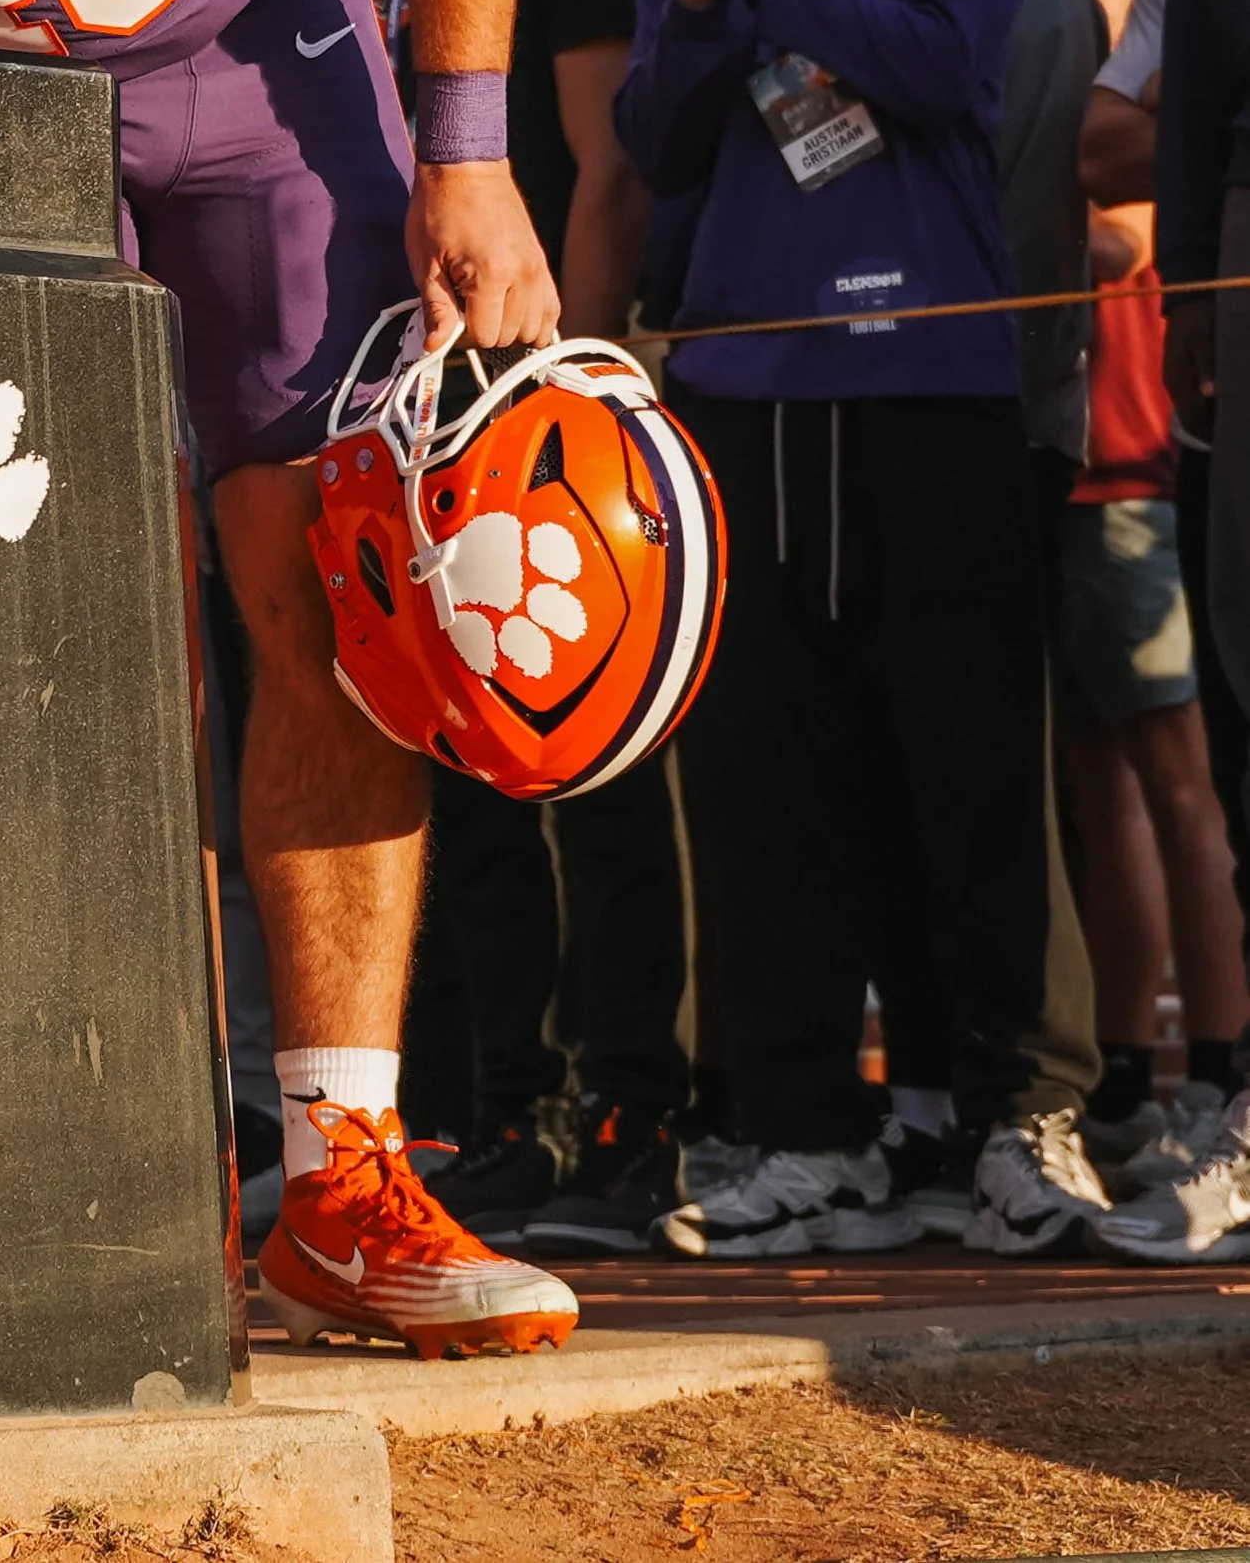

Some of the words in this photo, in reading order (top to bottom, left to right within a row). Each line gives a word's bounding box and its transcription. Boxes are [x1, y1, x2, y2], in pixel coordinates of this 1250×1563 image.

[801, 125, 864, 170] CRISTIAAN
[803, 117, 850, 153] AUSTAN
[835, 271, 902, 293] CLEMSON
